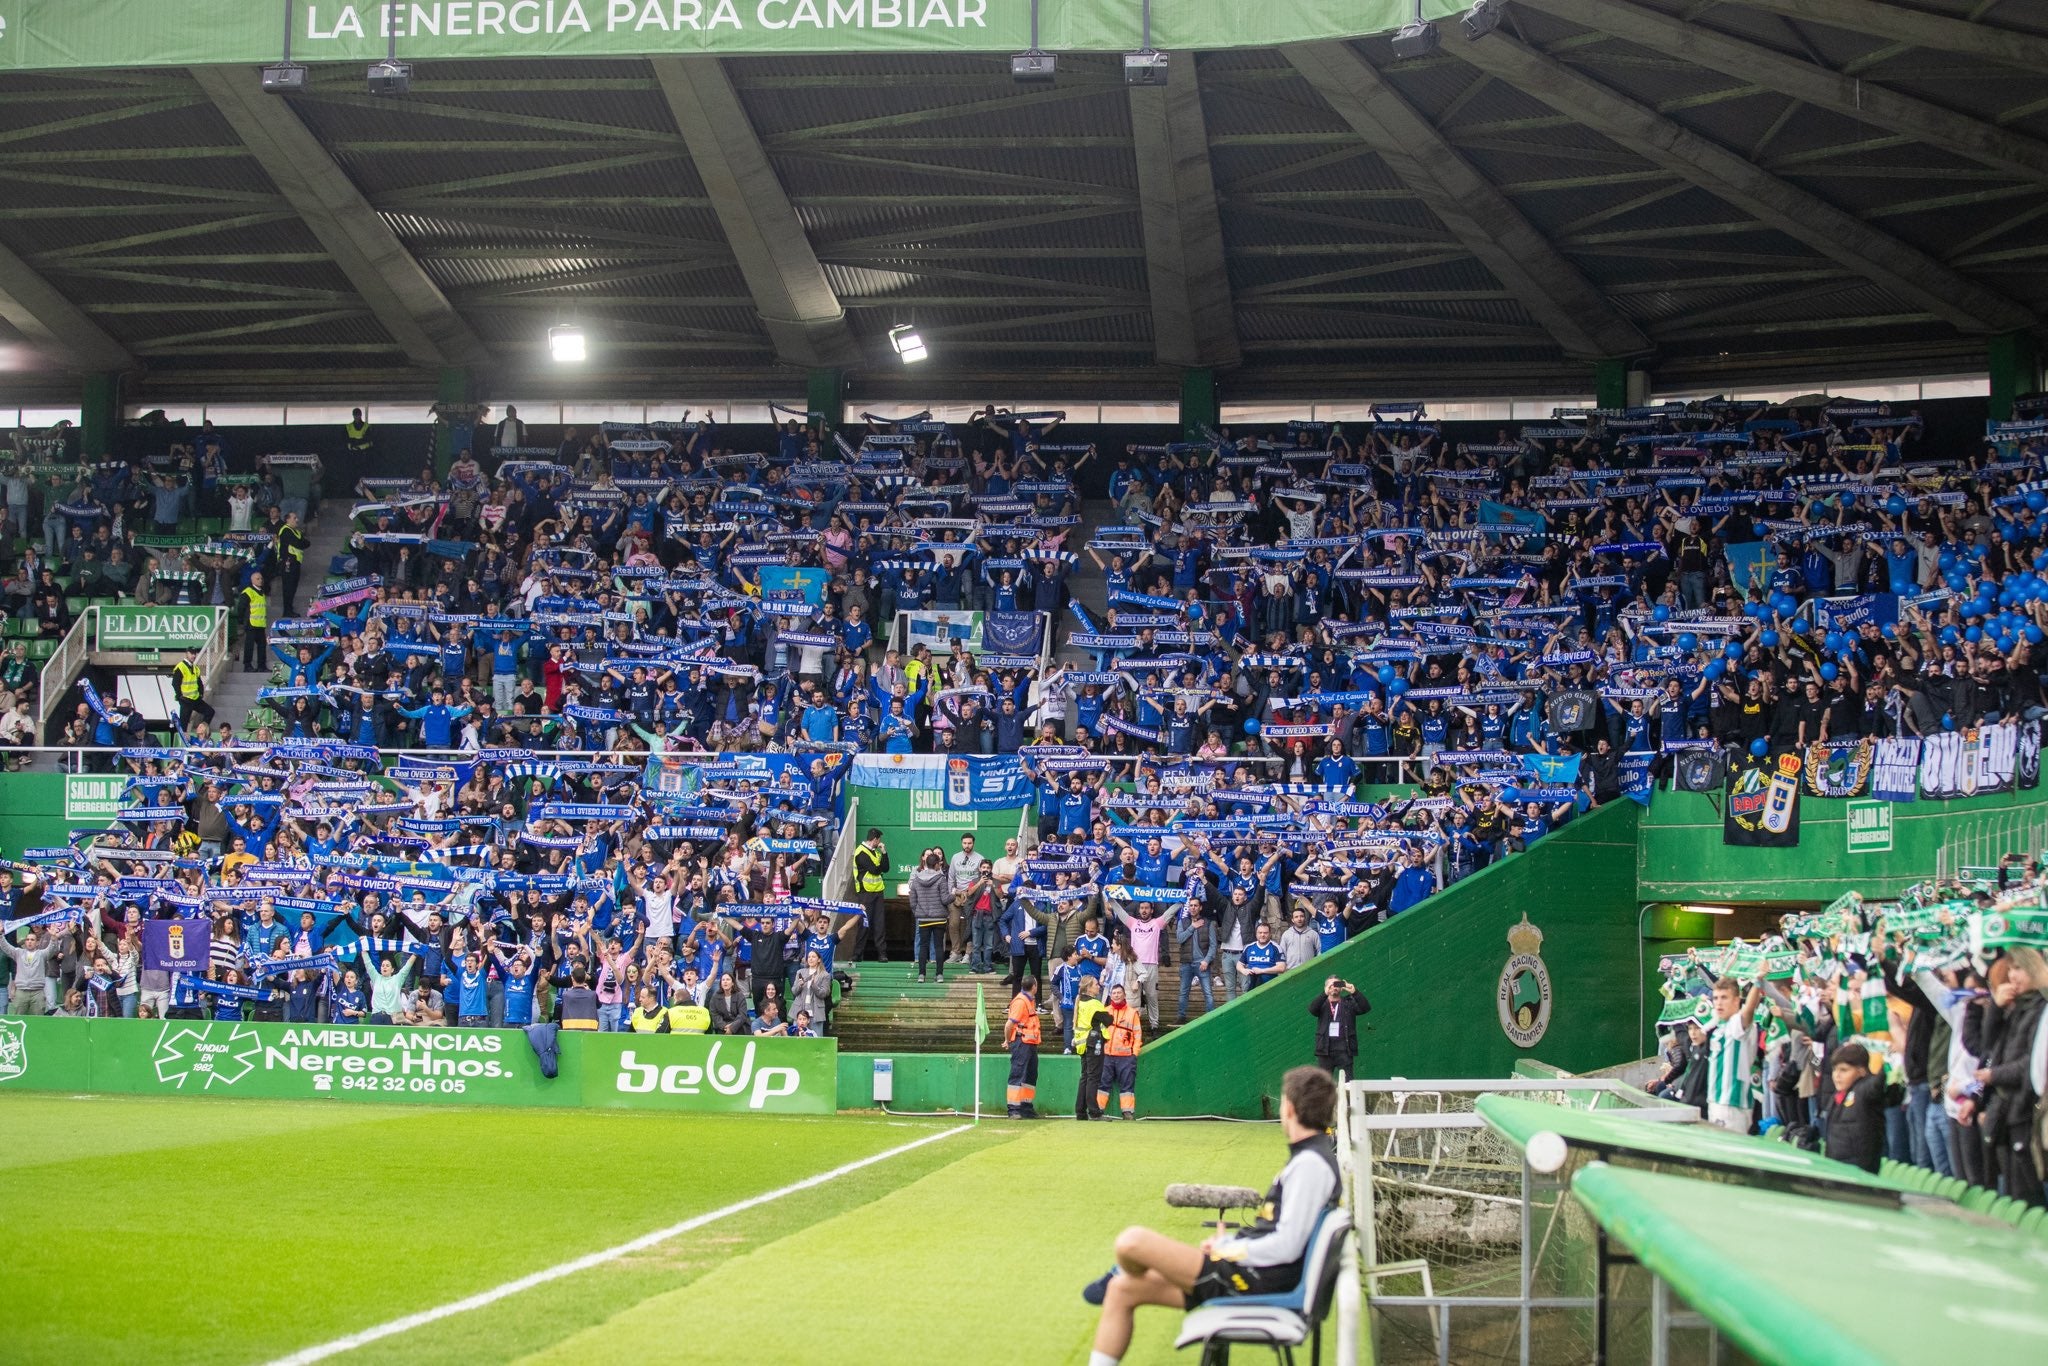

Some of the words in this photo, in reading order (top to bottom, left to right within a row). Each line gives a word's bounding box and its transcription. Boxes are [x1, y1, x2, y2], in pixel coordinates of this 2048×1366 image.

[308, 5, 365, 39] LA
[607, 0, 743, 32] PARA
[757, 0, 987, 29] CAMBIAR
[813, 465, 839, 474] OVIEDO
[762, 603, 772, 612] NO
[773, 603, 788, 612] HAY
[788, 603, 813, 613] TREGUA
[998, 612, 1013, 620] Peña
[105, 615, 132, 633] EL
[135, 615, 211, 633] DIARIO
[1417, 624, 1434, 632] Real
[1436, 625, 1467, 634] OVIEDO
[778, 633, 835, 644] INQUEBRANTABLES
[1073, 636, 1094, 645] REAL
[1104, 637, 1134, 646] OVIEDO
[1006, 658, 1034, 666] OVIEDO
[1118, 660, 1177, 668] INQUEBRANTABLES
[1069, 673, 1087, 681] Real
[1089, 674, 1119, 682] OVIEDO
[1550, 692, 1573, 709] NUEVO
[1270, 726, 1285, 734] Real
[1286, 726, 1307, 734] OVIEDO
[1307, 725, 1323, 734] 1926
[479, 751, 497, 760] Real
[498, 748, 532, 759] OVIEDO
[1046, 760, 1106, 768] INQUEBRANTABLES
[306, 764, 324, 773] Real
[326, 767, 358, 779] OVIEDO
[394, 770, 410, 778] Real
[411, 770, 434, 779] OVIEDO
[436, 771, 451, 779] 1926
[70, 782, 106, 799] SALIDA
[1734, 793, 1767, 812] RAPI
[132, 810, 145, 818] Real
[561, 807, 575, 815] Real
[577, 807, 601, 815] OVIEDO
[602, 808, 616, 816] 1926
[915, 812, 973, 822] EMERGENCIAS
[1876, 807, 1890, 827] DE
[405, 821, 419, 829] Real
[420, 823, 443, 831] OVIEDO
[660, 828, 671, 837] NO
[673, 828, 688, 837] HAY
[690, 828, 719, 836] TREGUA
[1850, 828, 1890, 843] EMERGENCIAS
[520, 832, 584, 845] INQUEBRANTABLES
[1384, 838, 1401, 847] 1926
[314, 854, 335, 862] Real
[337, 855, 363, 865] OVIEDO
[1029, 862, 1090, 870] INQUEBRANTABLES
[344, 877, 361, 886] Real
[363, 880, 394, 890] OVIEDO
[53, 885, 68, 893] Real
[69, 885, 92, 893] OVIEDO
[207, 888, 232, 898] REAL
[244, 889, 280, 898] OVIEDO
[276, 898, 290, 906] Real
[291, 901, 315, 909] OVIEDO
[317, 903, 333, 911] 1926
[1501, 972, 1511, 1000] REAL
[1512, 956, 1539, 970] RACING
[1538, 970, 1549, 1000] CLUB
[1506, 1022, 1544, 1042] SANTANDER
[280, 1029, 502, 1052] AMBULANCIAS
[194, 1043, 229, 1054] FUNDADA
[201, 1054, 215, 1062] EN
[266, 1046, 394, 1073] Nereo
[402, 1051, 513, 1078] Hnos.
[192, 1063, 213, 1072] 1982
[342, 1075, 378, 1090] 942
[382, 1076, 405, 1091] 32
[410, 1078, 436, 1092] 06
[440, 1079, 466, 1094] 05
